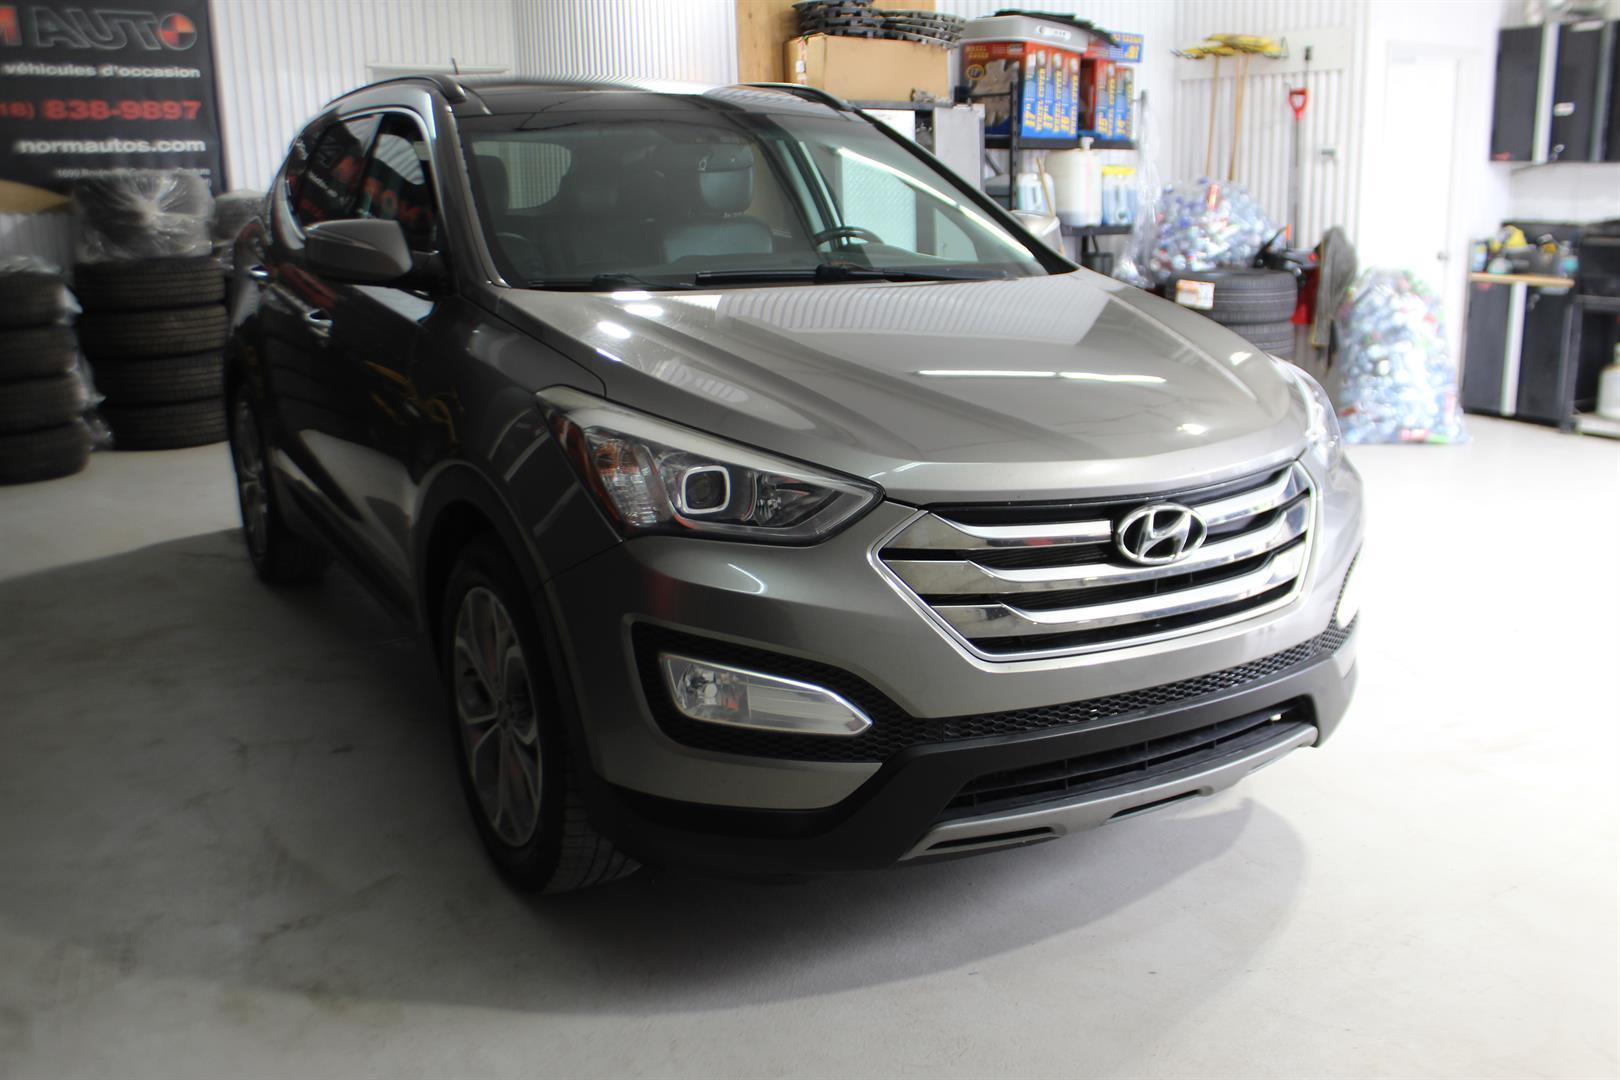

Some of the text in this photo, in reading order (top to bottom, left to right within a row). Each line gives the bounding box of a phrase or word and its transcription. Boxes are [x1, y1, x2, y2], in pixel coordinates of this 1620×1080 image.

[3, 62, 200, 78] véhicules d'occasion
[43, 100, 201, 120] 838-9897
[17, 138, 206, 154] normautos.com
